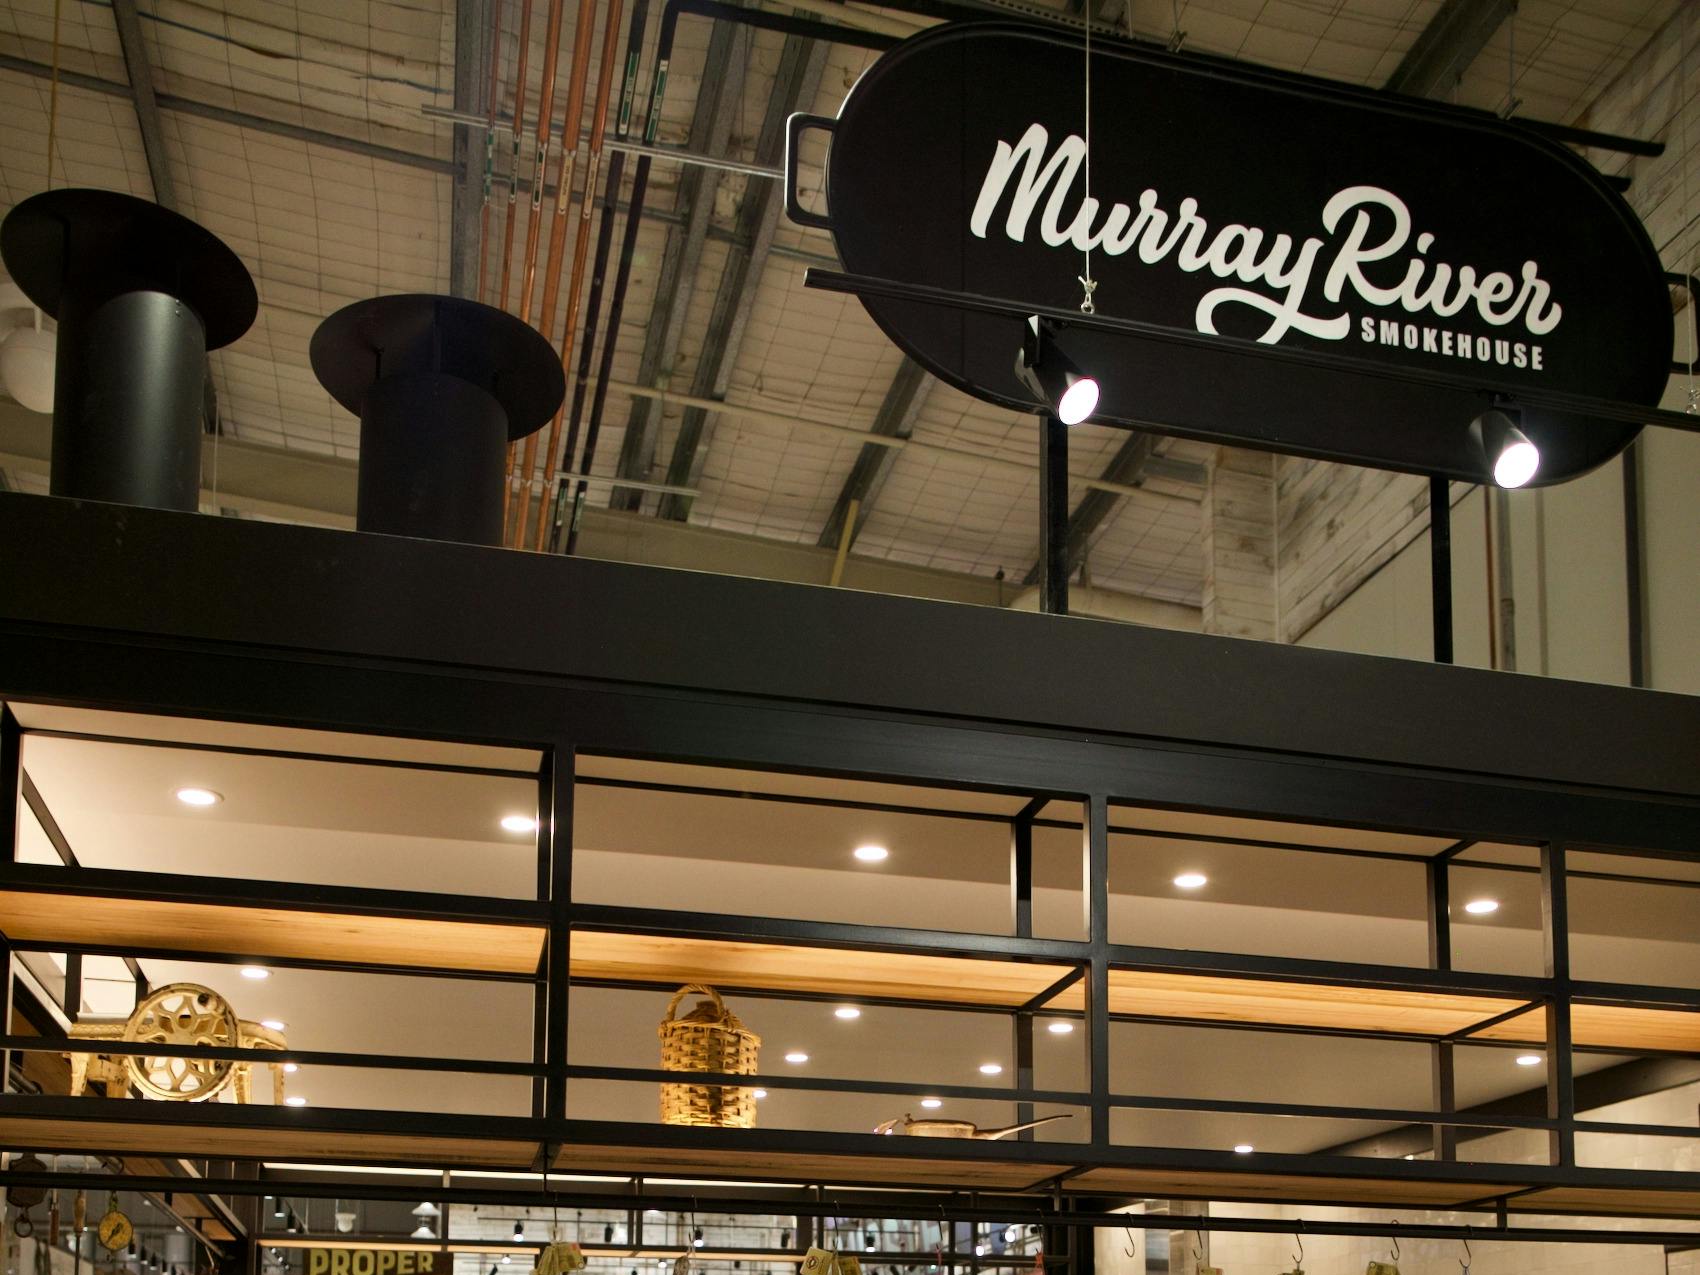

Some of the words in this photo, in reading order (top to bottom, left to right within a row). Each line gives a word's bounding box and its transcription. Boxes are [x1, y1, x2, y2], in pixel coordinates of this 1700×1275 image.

[971, 123, 1351, 345] Murray
[1322, 185, 1562, 335] River
[1361, 316, 1543, 370] SMOKEHOUSE
